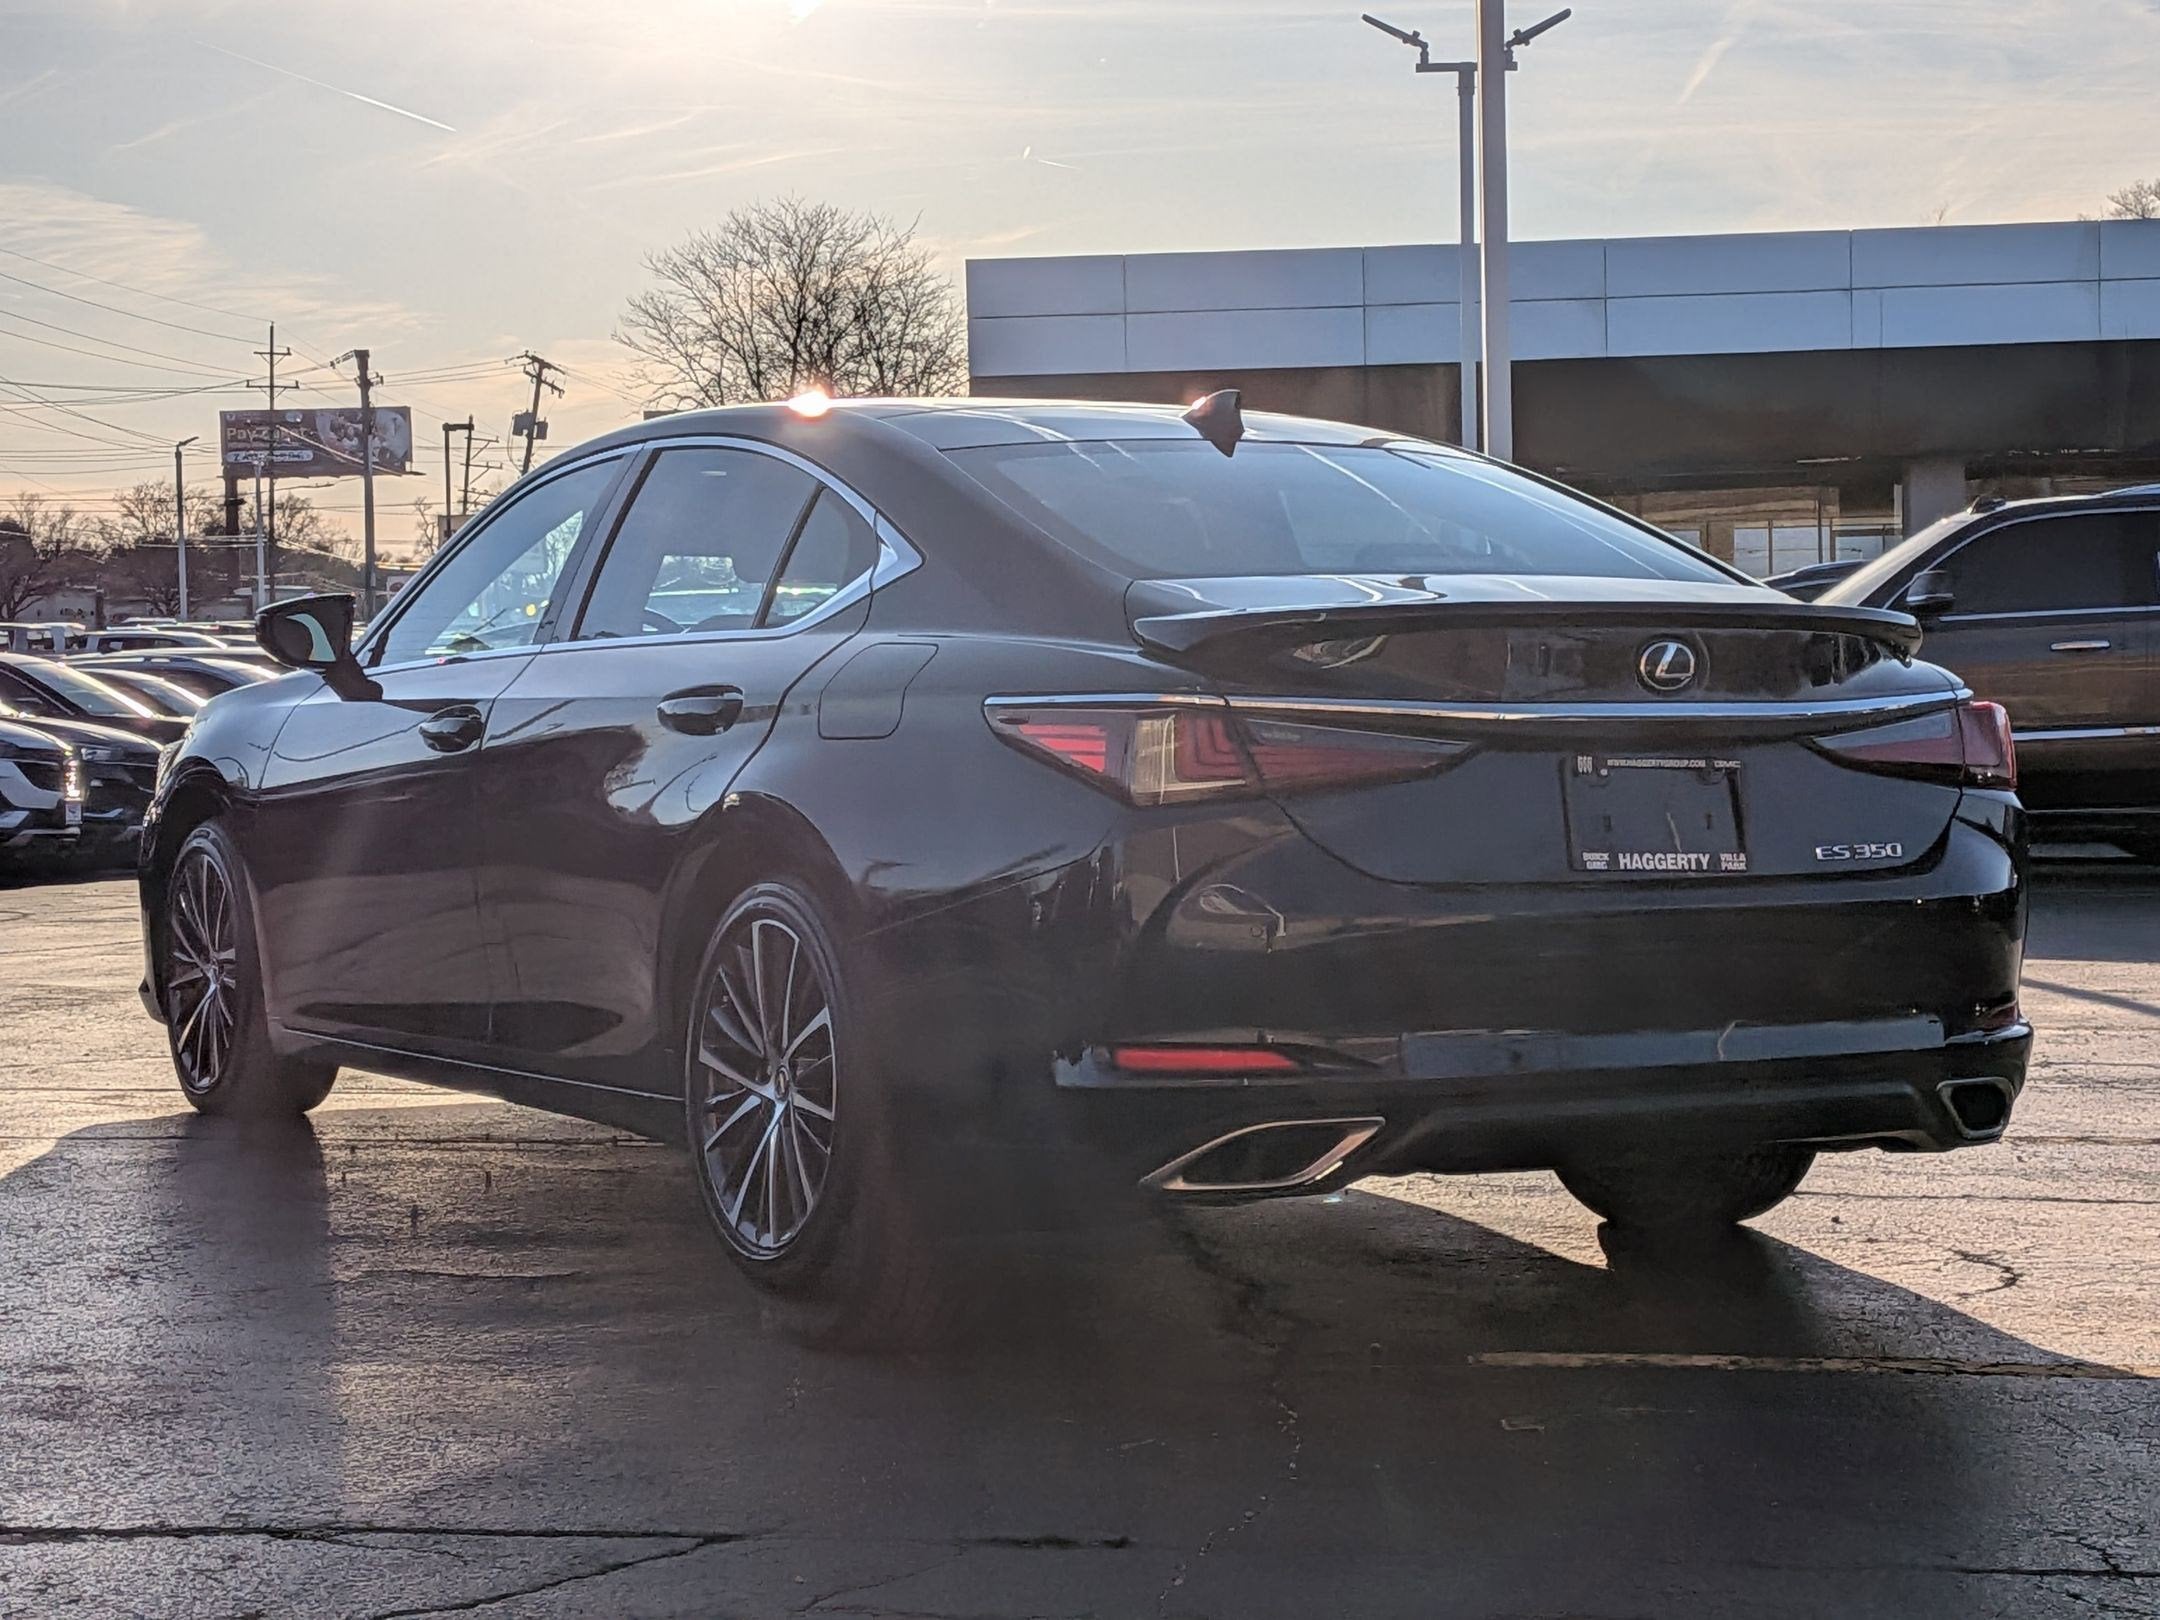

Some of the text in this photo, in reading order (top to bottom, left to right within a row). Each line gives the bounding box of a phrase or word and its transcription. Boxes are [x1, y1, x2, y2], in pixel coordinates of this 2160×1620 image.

[1815, 842, 1902, 860] ES 350
[1618, 852, 1711, 871] HAGGERTY
